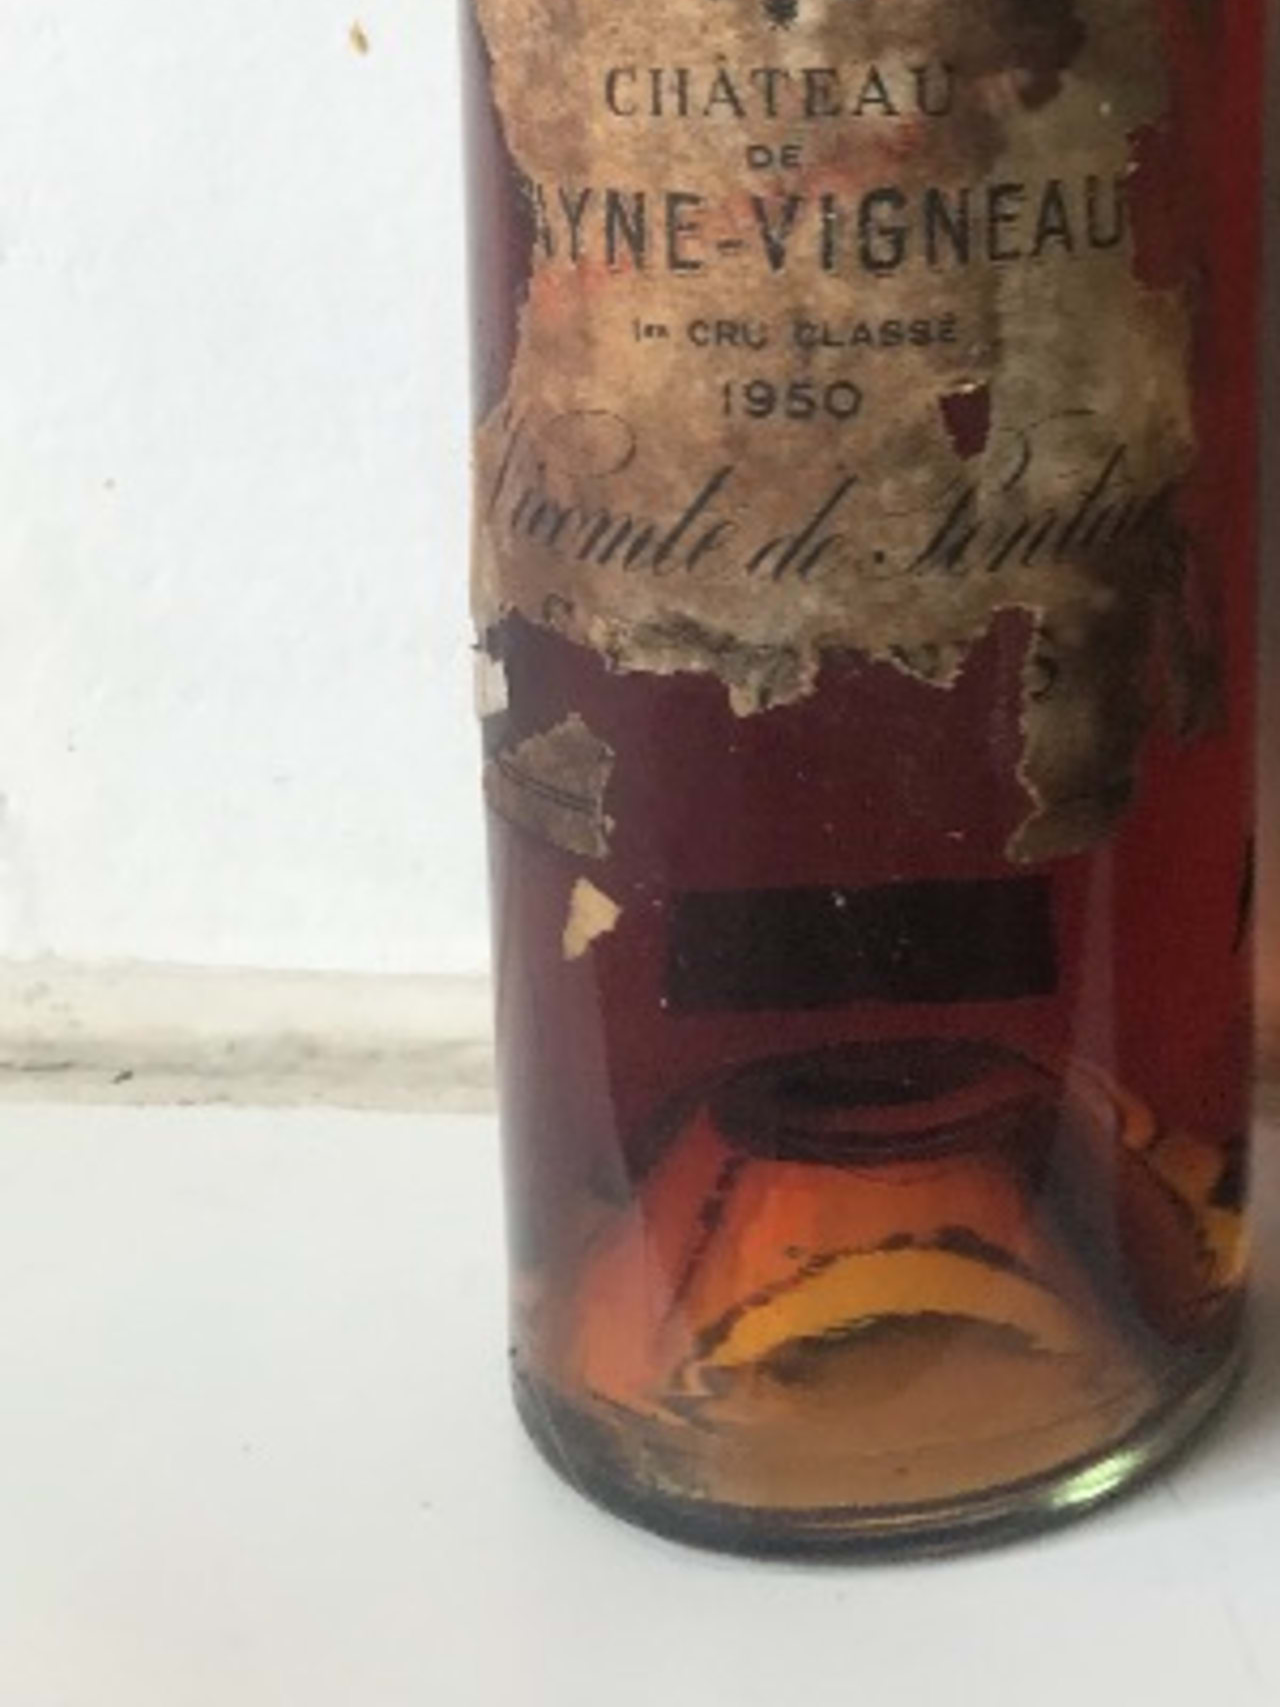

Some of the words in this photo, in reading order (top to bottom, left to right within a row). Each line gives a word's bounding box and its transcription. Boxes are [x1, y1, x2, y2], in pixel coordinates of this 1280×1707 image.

[748, 144, 803, 170] DE
[687, 319, 768, 351] CRU
[793, 310, 958, 350] CLASSÉ
[723, 379, 864, 422] 1950
